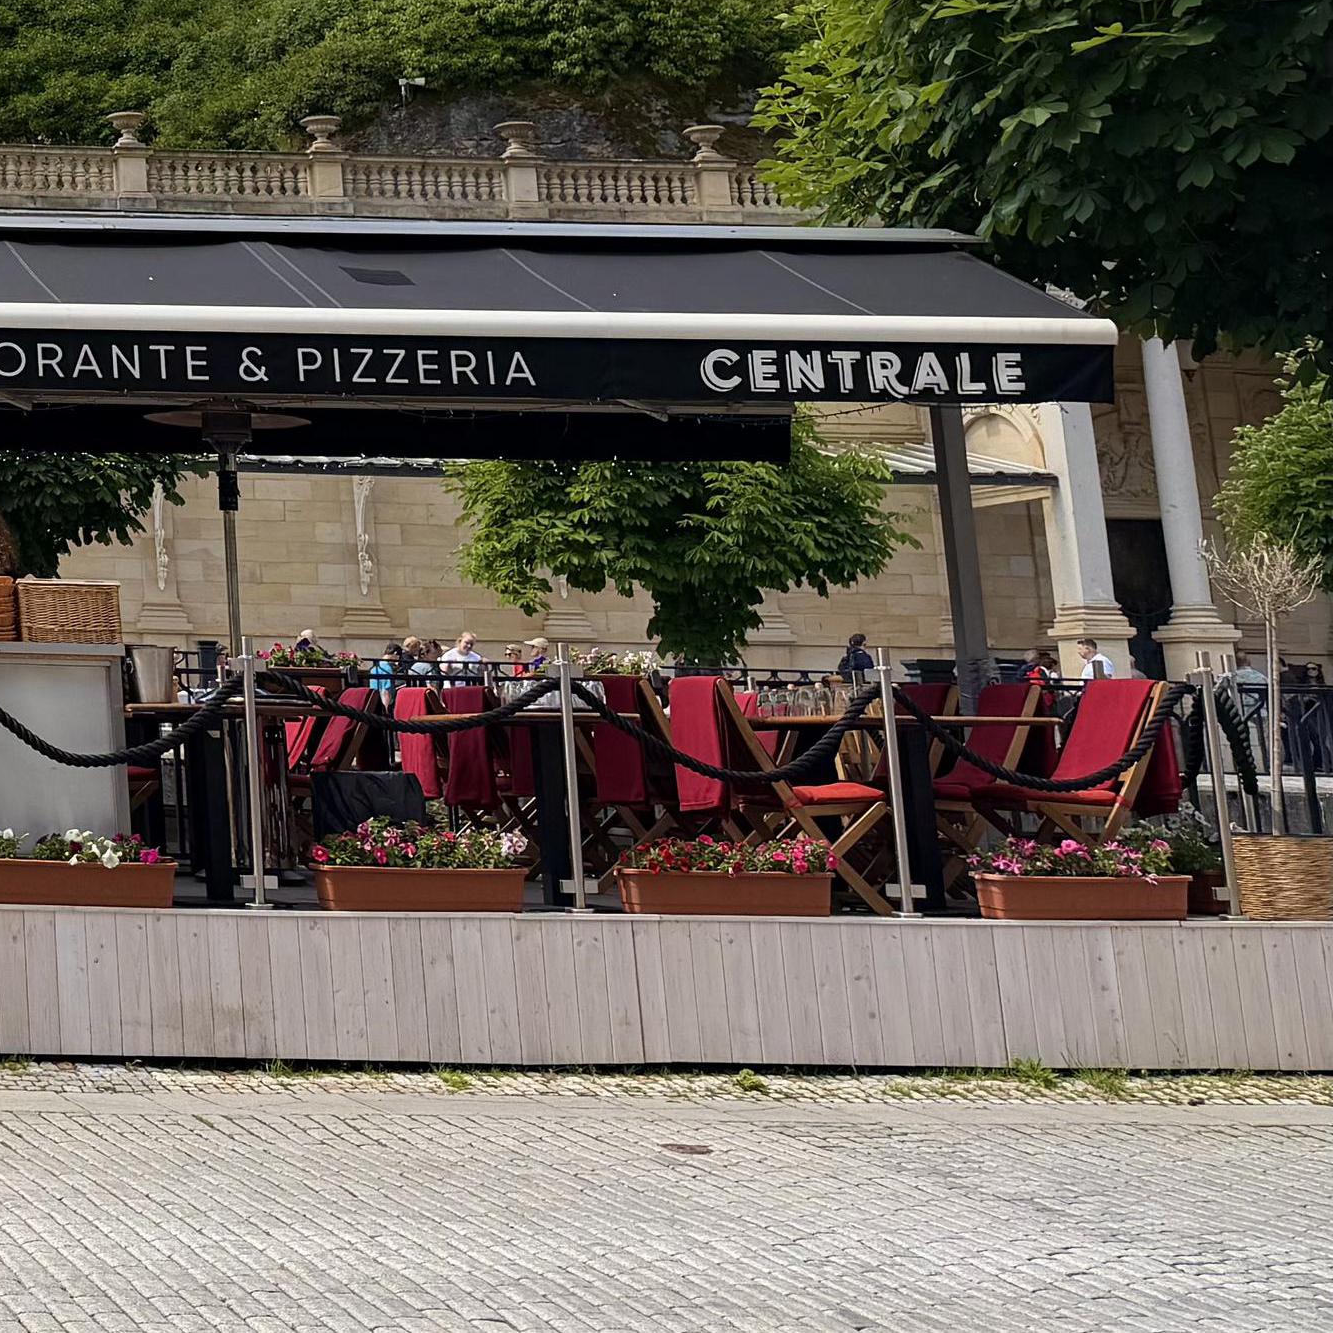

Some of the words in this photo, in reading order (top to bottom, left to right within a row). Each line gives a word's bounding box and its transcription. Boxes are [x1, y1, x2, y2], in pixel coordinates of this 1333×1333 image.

[238, 346, 269, 382] &
[297, 347, 536, 386] PIZZERIA
[700, 348, 1026, 398] CENTRALE
